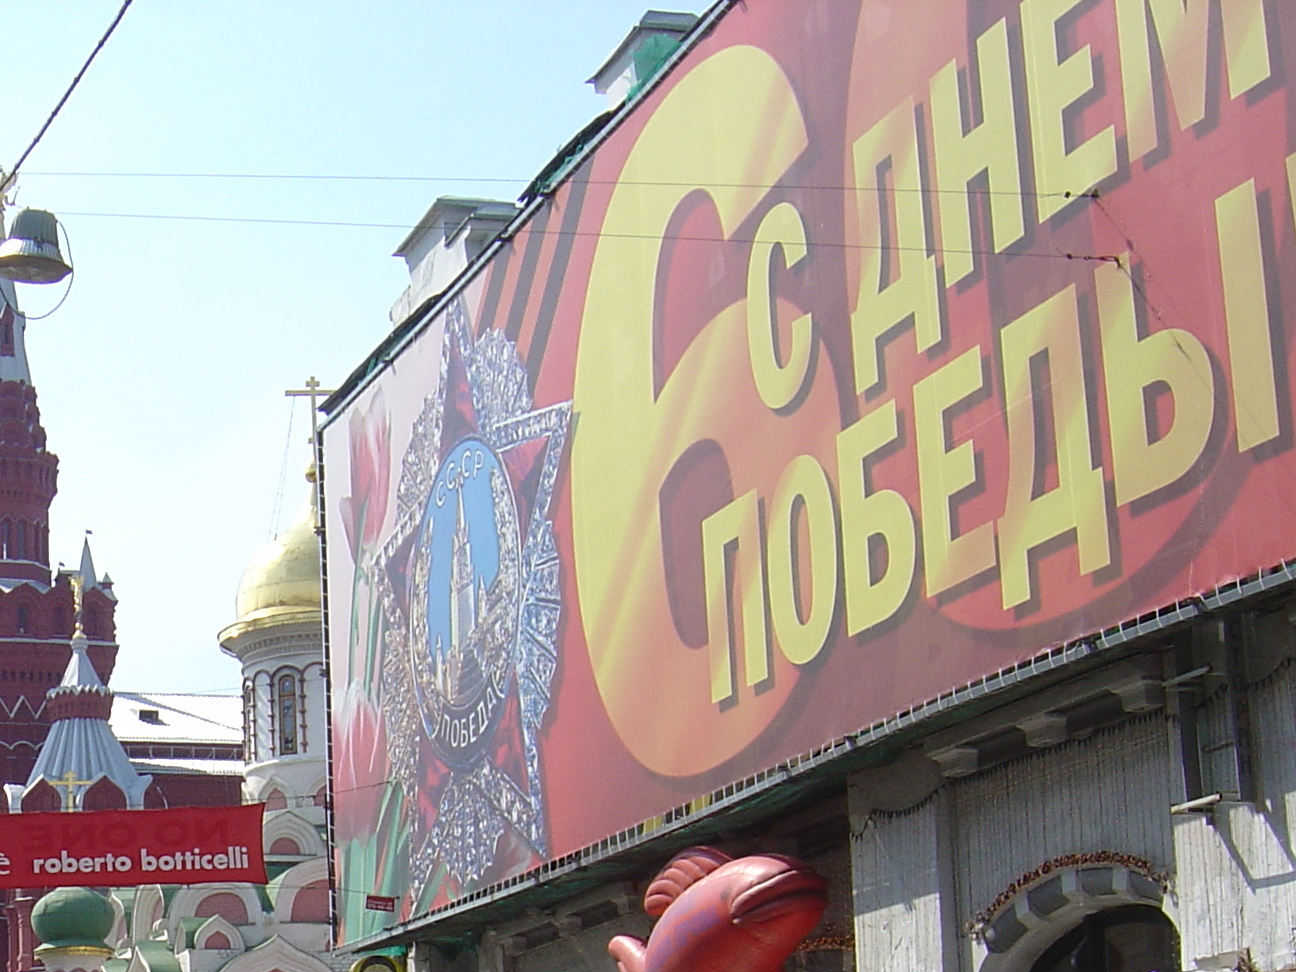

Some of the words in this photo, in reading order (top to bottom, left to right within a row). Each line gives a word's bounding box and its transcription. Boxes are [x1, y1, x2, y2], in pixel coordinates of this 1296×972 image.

[746, 202, 811, 410] С
[851, 0, 1271, 395] ДНЕМ
[702, 156, 1296, 704] ПОБЕДЫ
[435, 449, 484, 507] СССР
[441, 685, 498, 748] ПОБЕДА
[33, 850, 132, 875] roberto
[140, 846, 249, 872] botticelli
